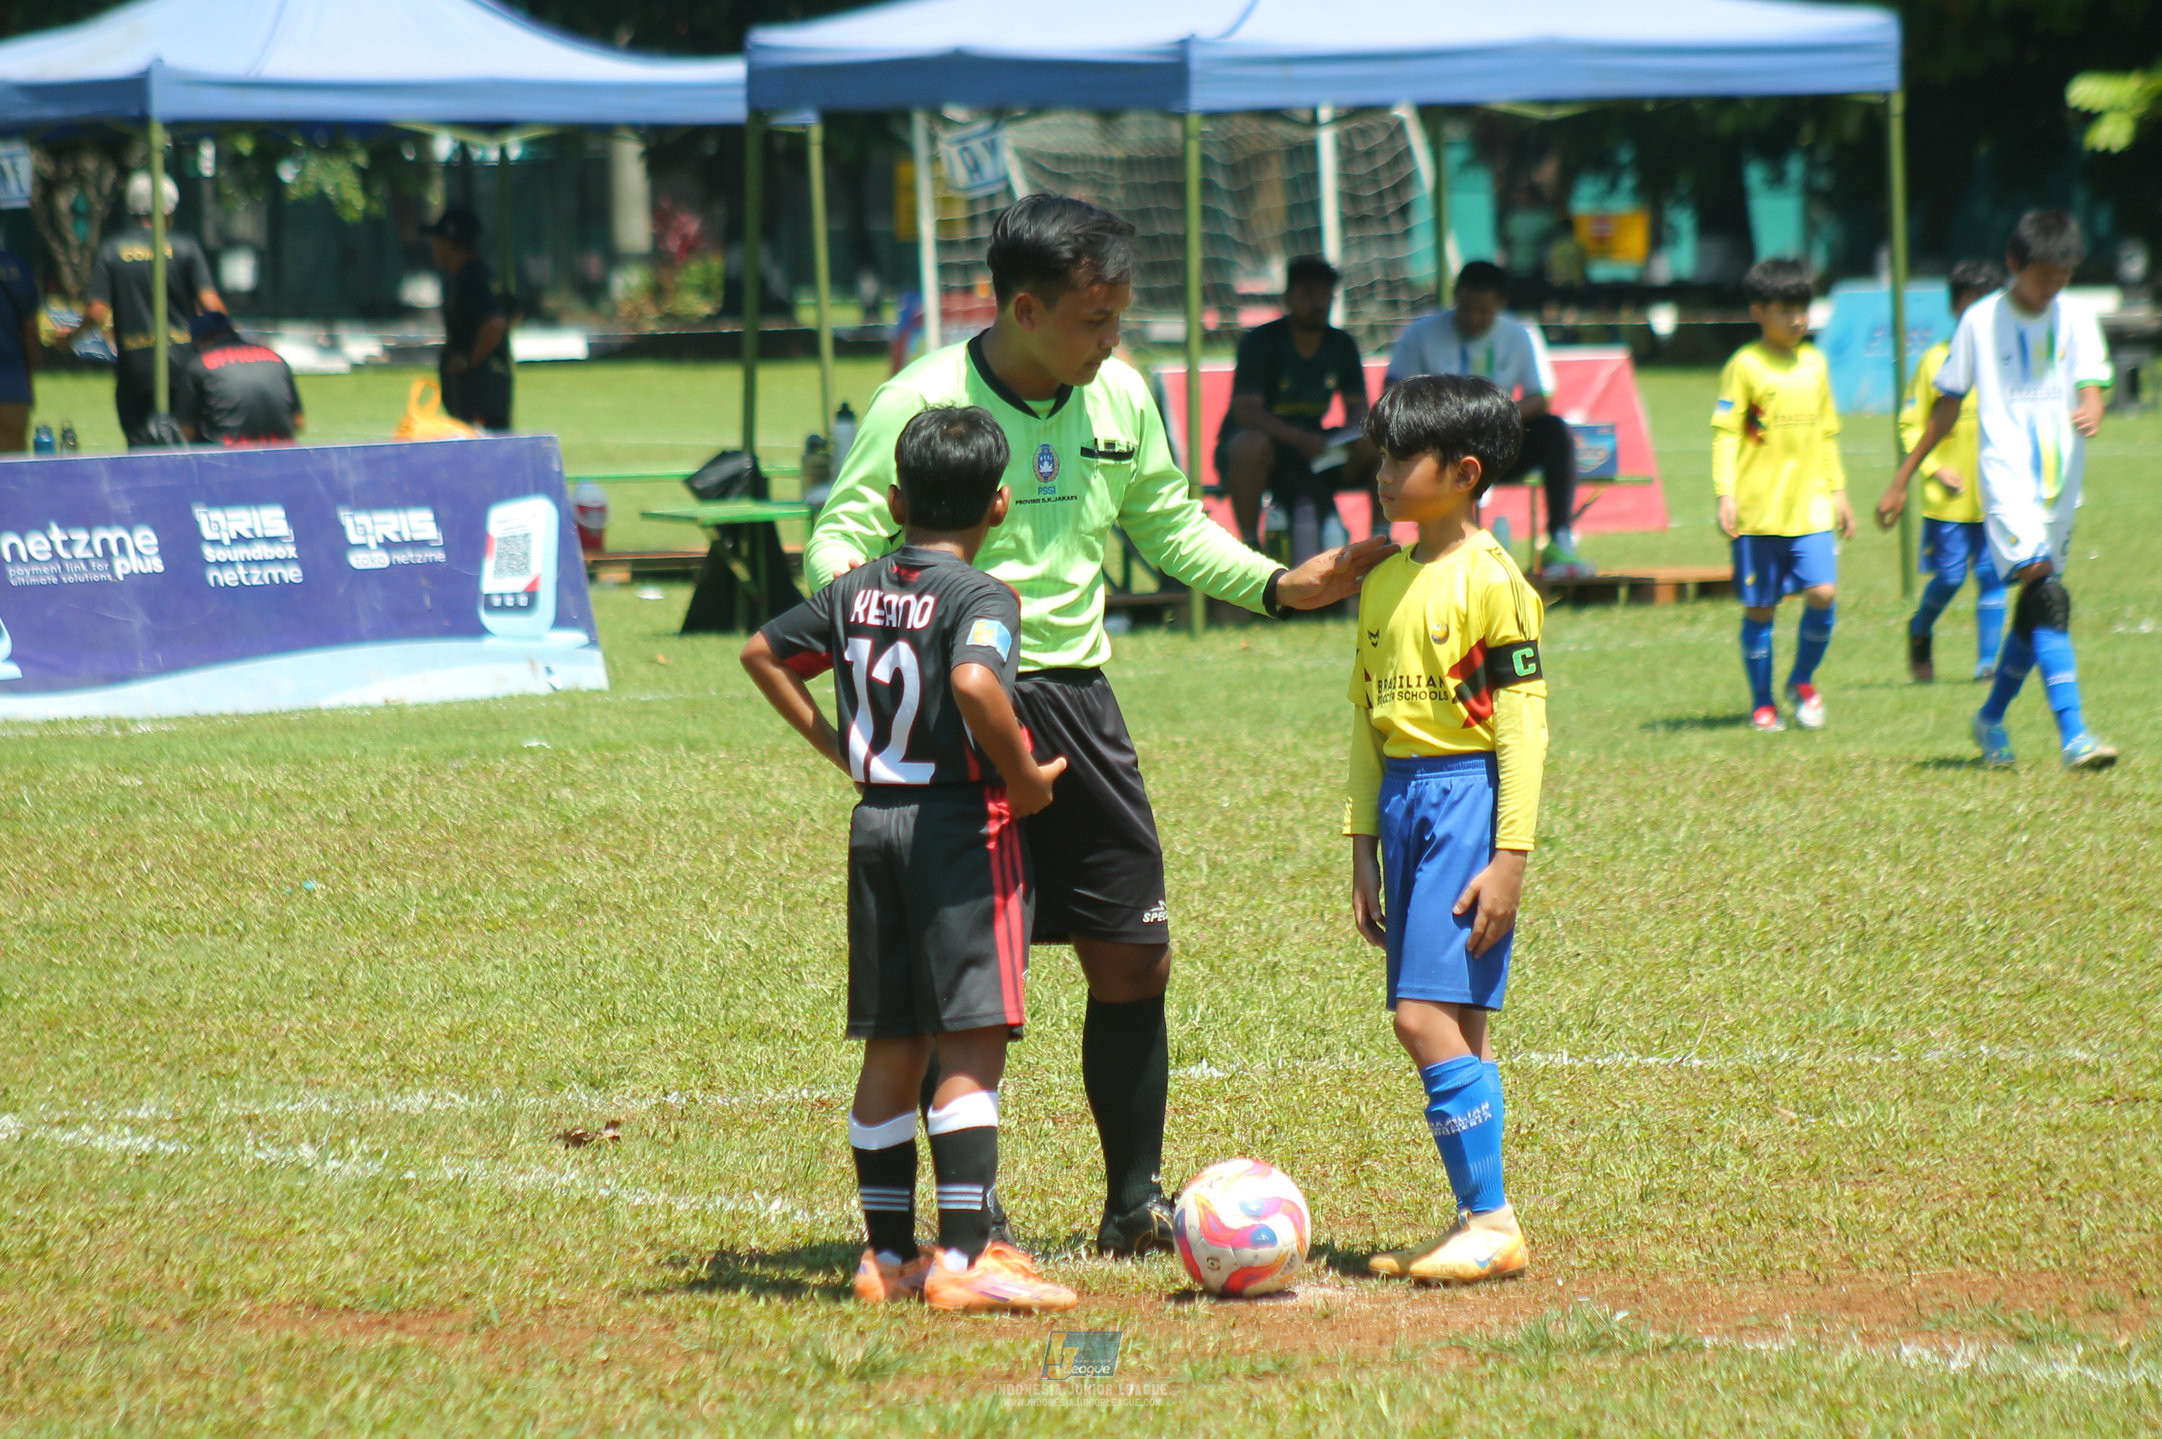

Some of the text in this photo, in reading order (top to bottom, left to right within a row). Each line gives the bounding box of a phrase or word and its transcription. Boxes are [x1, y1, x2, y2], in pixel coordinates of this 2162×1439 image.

[1038, 486, 1056, 496] PSSI
[0, 520, 159, 562] netzme
[112, 549, 165, 581] plus
[392, 548, 446, 565] netzme
[9, 561, 110, 578] payment link for
[10, 573, 114, 586] ultimate solutions
[206, 562, 304, 587] netzme
[850, 589, 936, 630] KEANO
[1512, 647, 1537, 677] C
[1397, 690, 1449, 702] SCHOOLS
[844, 638, 936, 784] 12
